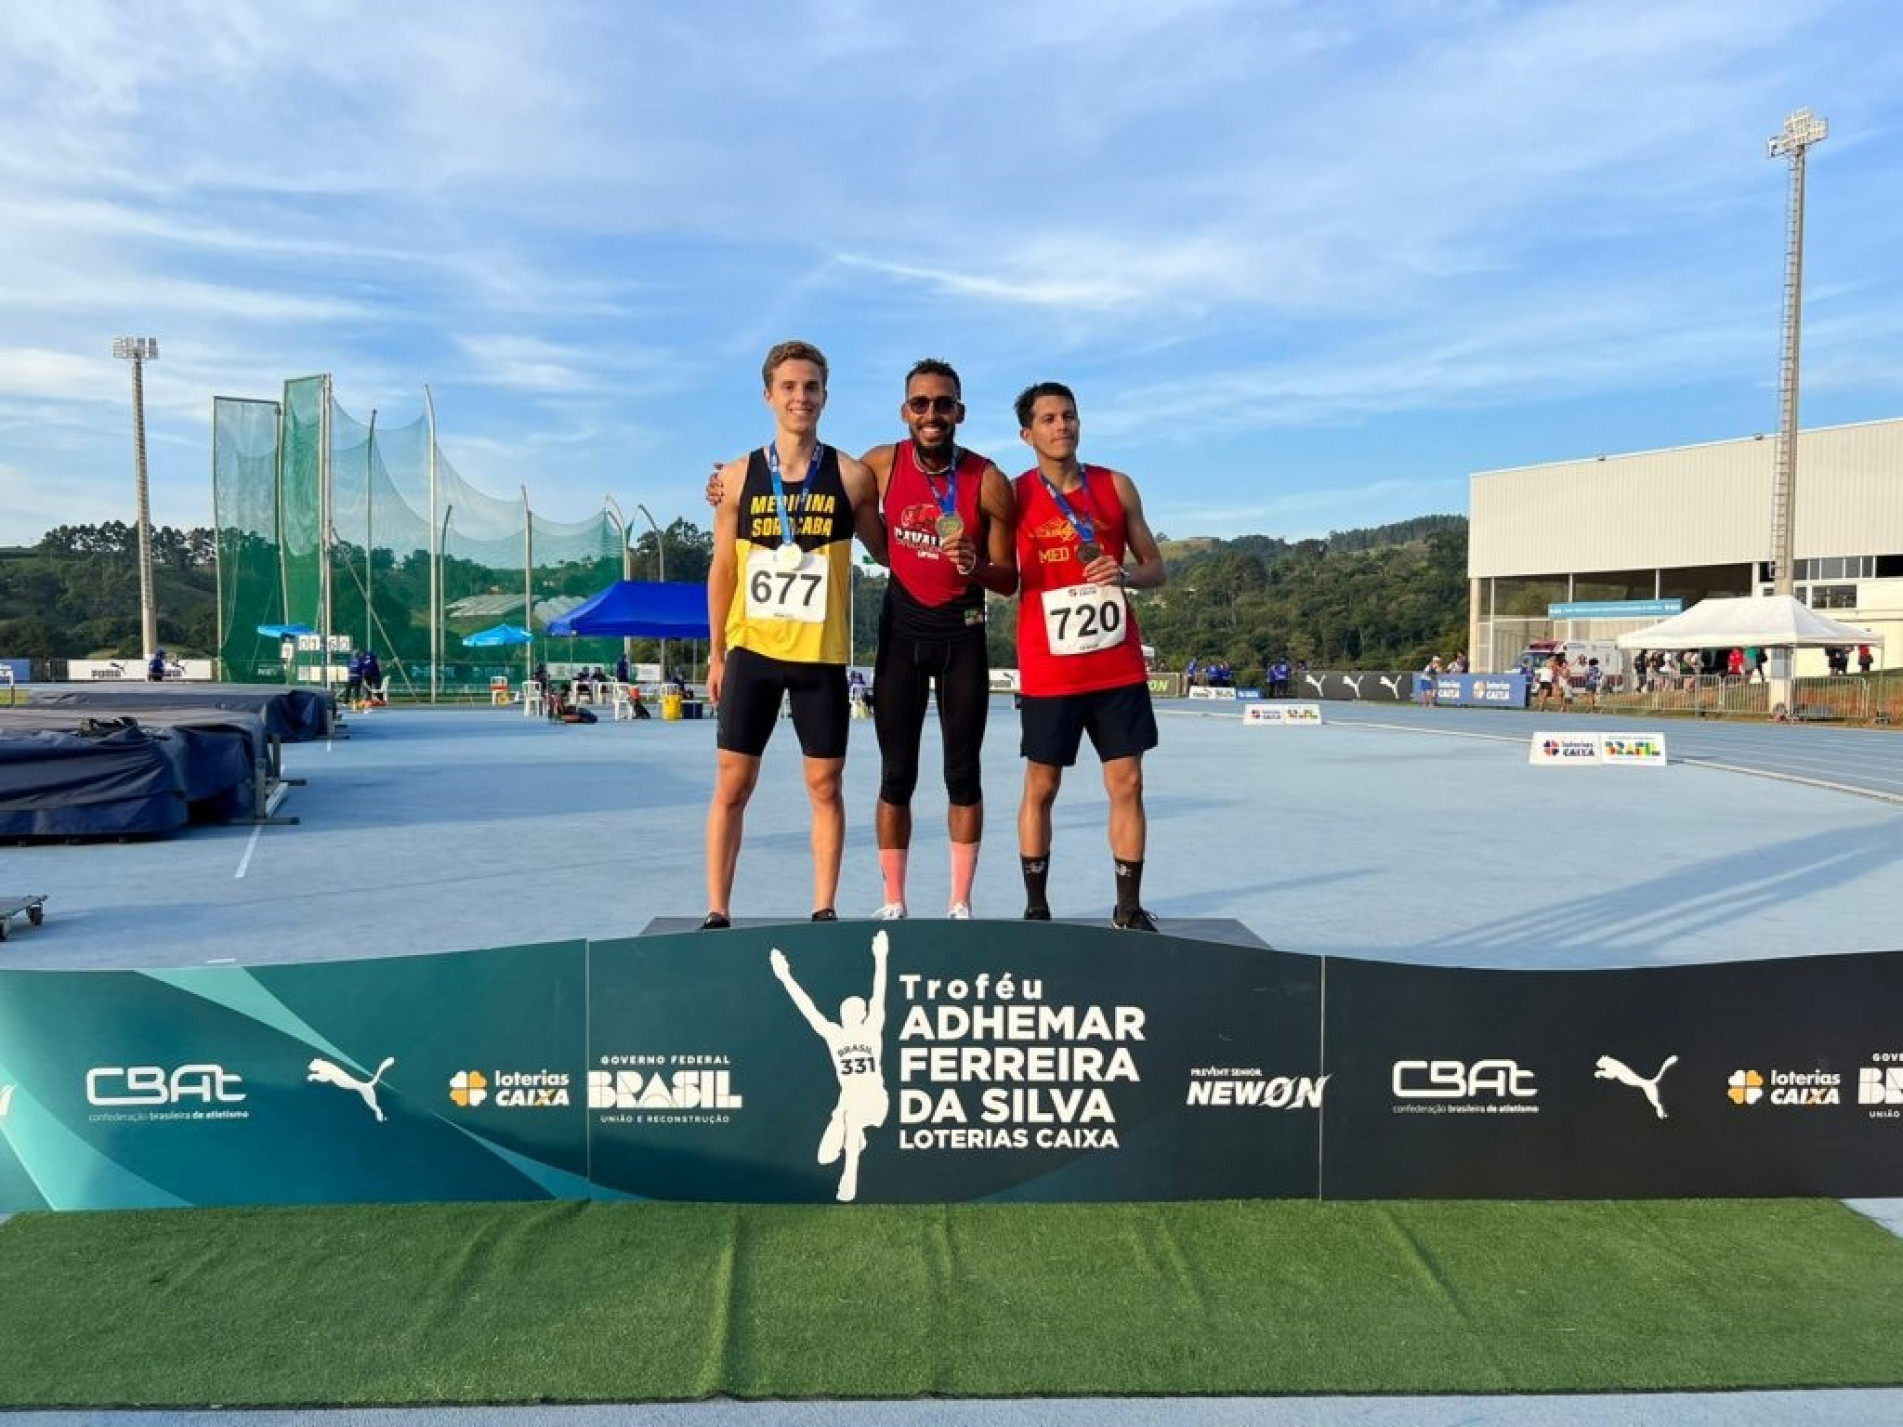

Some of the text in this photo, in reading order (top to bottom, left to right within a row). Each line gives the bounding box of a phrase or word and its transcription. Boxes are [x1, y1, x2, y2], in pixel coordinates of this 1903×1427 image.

[751, 570, 822, 606] 677
[1050, 600, 1120, 640] 720
[899, 972, 1043, 1000] Troféu
[899, 1005, 1146, 1041] ADHEMAR
[600, 1055, 731, 1065] GOVERNO FEDERAL
[840, 1056, 876, 1076] 331
[900, 1047, 1141, 1082] FERREIRA
[86, 1064, 247, 1106] CBAt
[495, 1070, 569, 1086] loterias
[587, 1070, 743, 1109] BRASIL
[1392, 1059, 1538, 1098] CBAt
[1771, 1069, 1841, 1086] loterias
[495, 1088, 570, 1107] CAIXA
[900, 1087, 1116, 1124] DA SILVA
[1487, 1104, 1497, 1113] de
[1770, 1088, 1841, 1105] CAIXA
[600, 1114, 730, 1126] UNIÃO E RECONSTRUÇÃO
[900, 1129, 1119, 1149] LOTERIAS CAIXA
